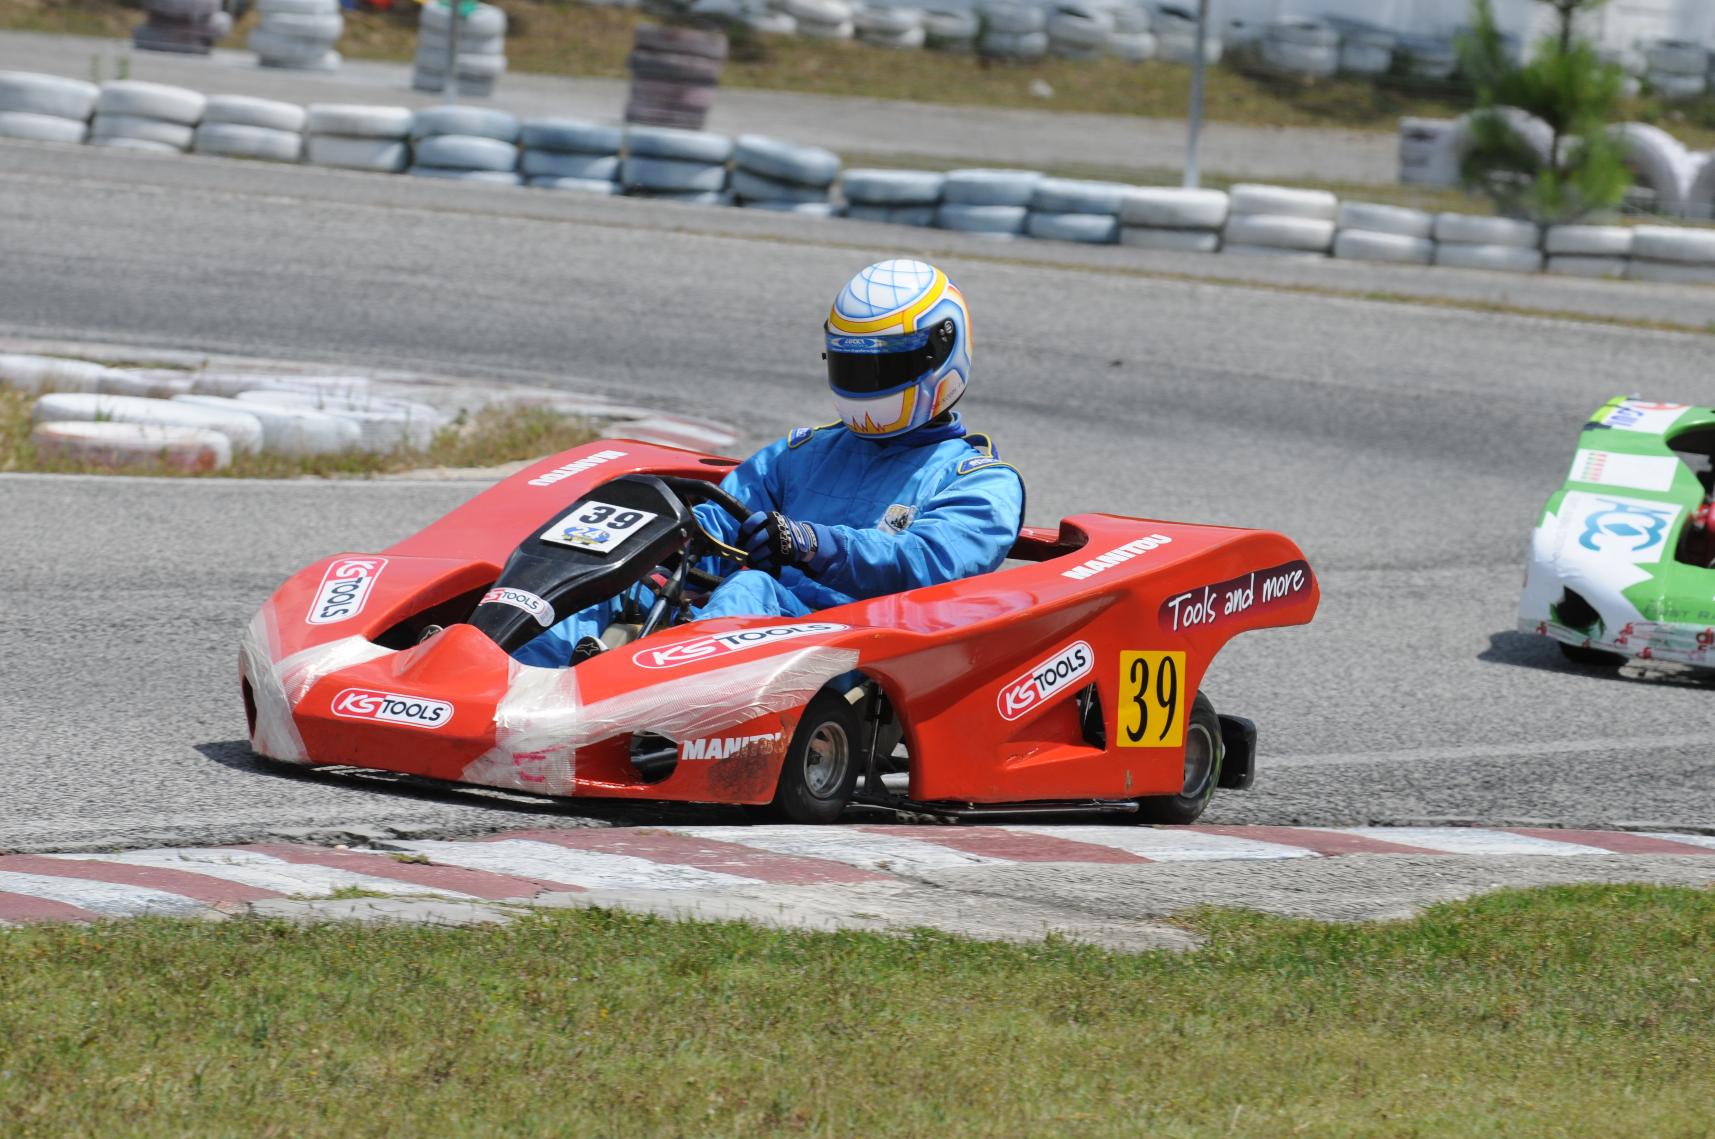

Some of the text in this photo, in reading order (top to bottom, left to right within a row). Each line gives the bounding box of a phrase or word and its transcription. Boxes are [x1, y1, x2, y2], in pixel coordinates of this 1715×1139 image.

[579, 505, 645, 530] 39
[1061, 533, 1173, 581] MANITOU
[1168, 569, 1305, 632] Tools and more
[1126, 655, 1178, 742] 39
